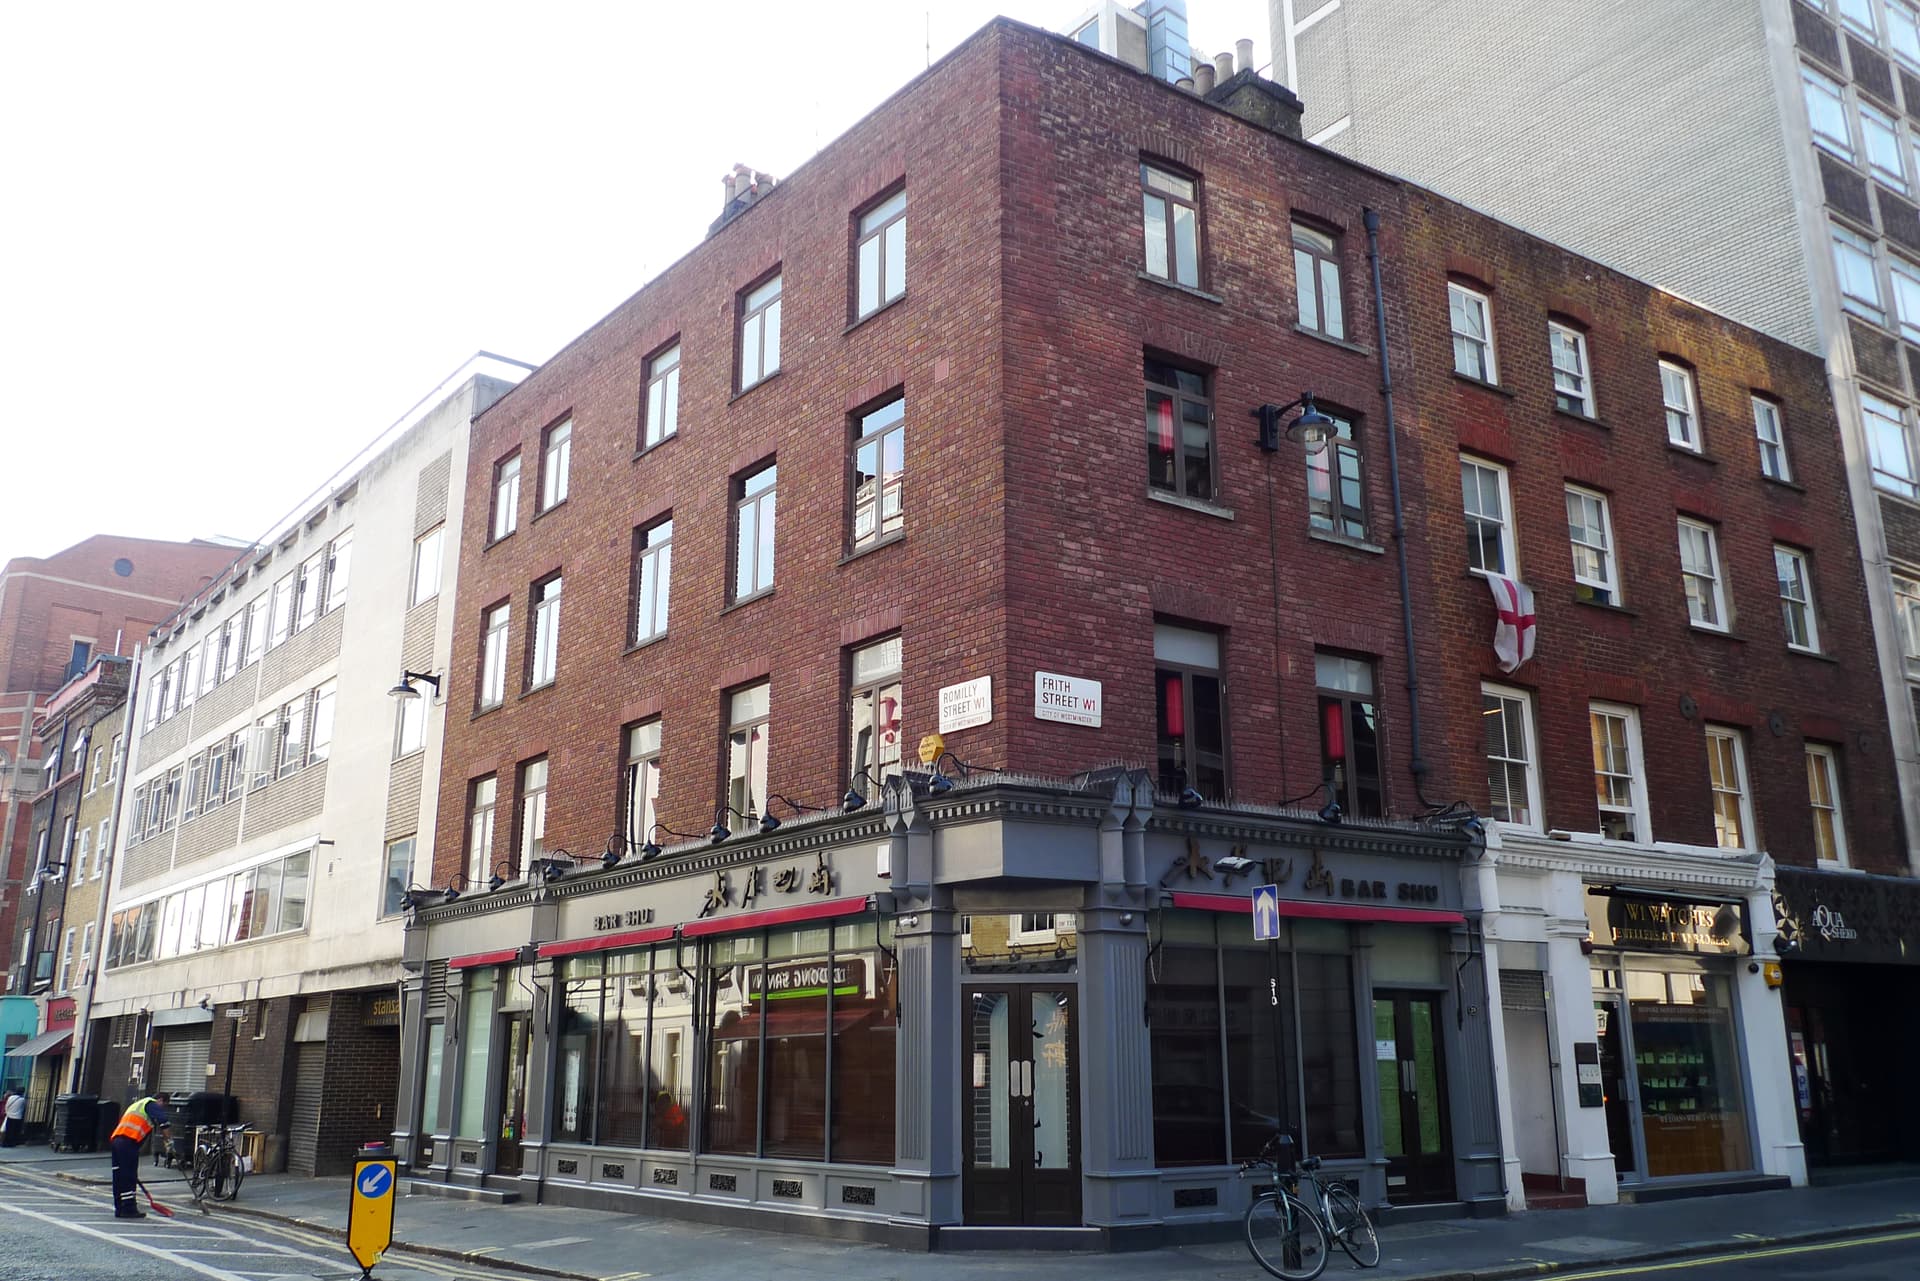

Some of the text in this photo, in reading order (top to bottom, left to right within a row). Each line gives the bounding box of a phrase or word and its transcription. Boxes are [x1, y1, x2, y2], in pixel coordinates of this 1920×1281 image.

[943, 684, 977, 704] ROMILLY
[1042, 677, 1071, 693] FRITH
[943, 697, 985, 718] STREET W1
[1042, 692, 1096, 711] STREET W1
[1341, 878, 1438, 902] BAR SHU
[593, 908, 652, 930] BAR SHU
[1625, 902, 1714, 928] W1 WATCHES
[1812, 904, 1845, 942] AQUA
